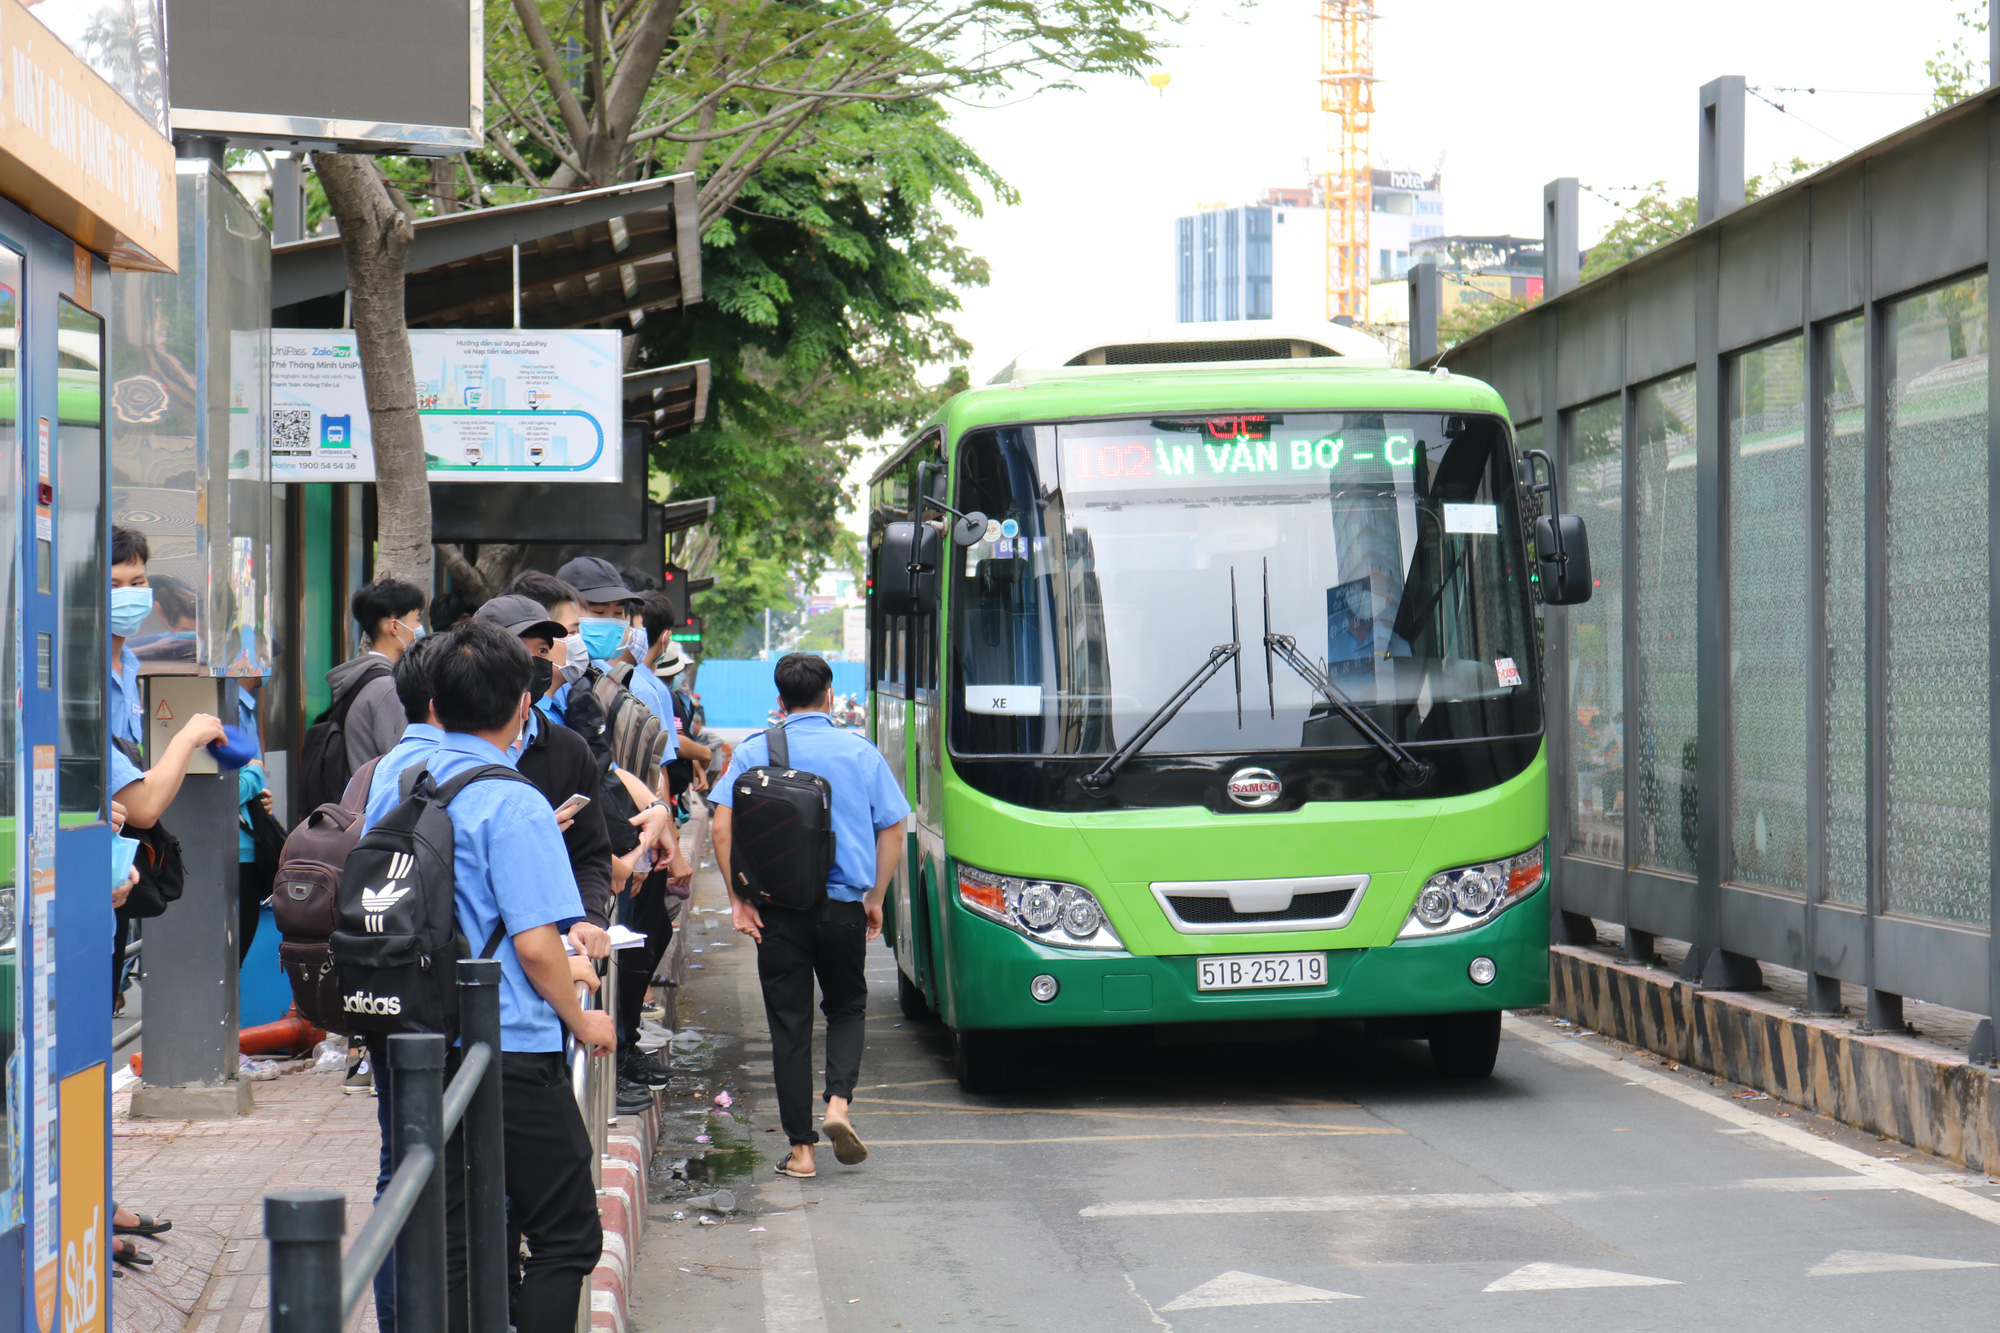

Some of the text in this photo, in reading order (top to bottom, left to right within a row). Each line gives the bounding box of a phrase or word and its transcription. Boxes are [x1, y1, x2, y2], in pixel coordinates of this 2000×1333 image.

[13, 40, 162, 231] MÁY BÁN HÀNG TỰ ĐỘNG
[271, 346, 350, 357] UniPass ZaloPay
[1076, 446, 1152, 478] 102
[1205, 434, 1278, 473] VĂN
[992, 697, 1007, 709] XE
[1232, 782, 1278, 793] SAMCO
[1202, 957, 1321, 986] 51B-252.19
